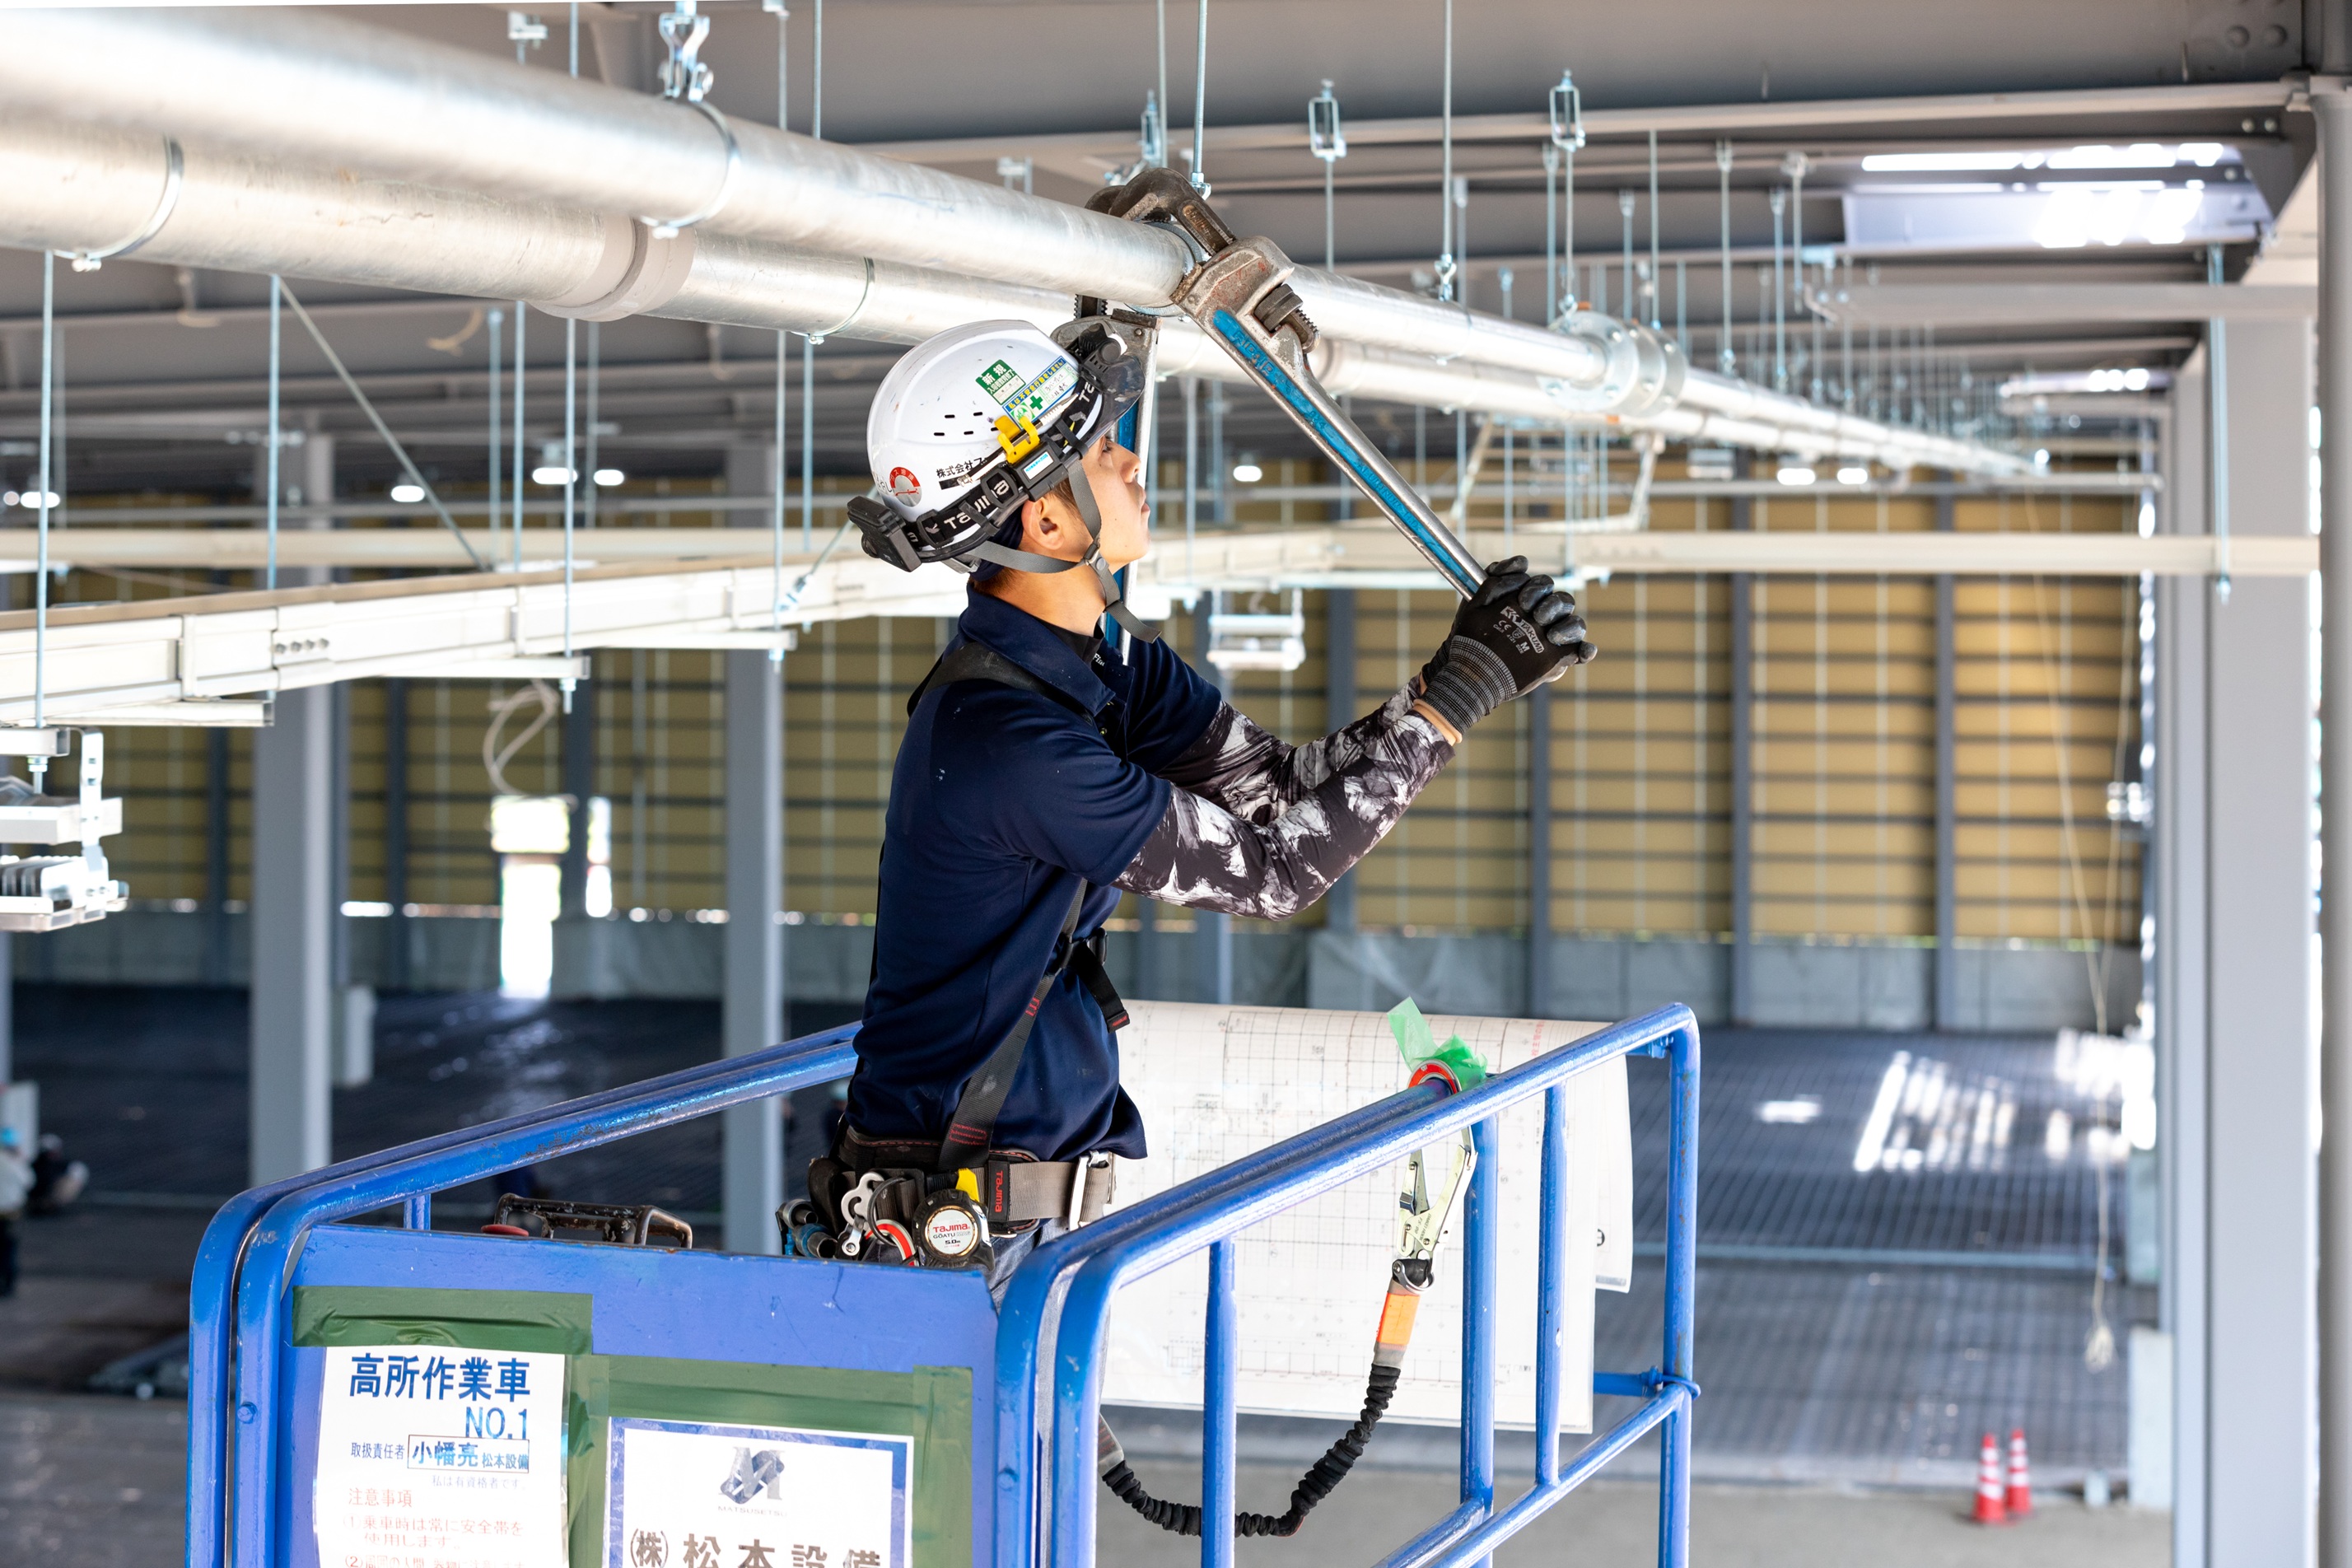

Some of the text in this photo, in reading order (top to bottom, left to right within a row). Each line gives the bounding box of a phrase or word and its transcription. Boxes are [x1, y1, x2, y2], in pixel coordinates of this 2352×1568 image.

[982, 364, 1006, 385] 新規
[1520, 642, 1530, 651] M
[349, 1352, 530, 1402] 高所作業車
[464, 1406, 528, 1440] NO.1
[351, 1441, 529, 1470] 取扱責任者 小幡亮 松本設備
[432, 1475, 526, 1491] 私は有資格者です。
[348, 1487, 413, 1508] 注意事項
[717, 1505, 788, 1517] MATSUSETSU
[364, 1533, 460, 1550] 使用します。
